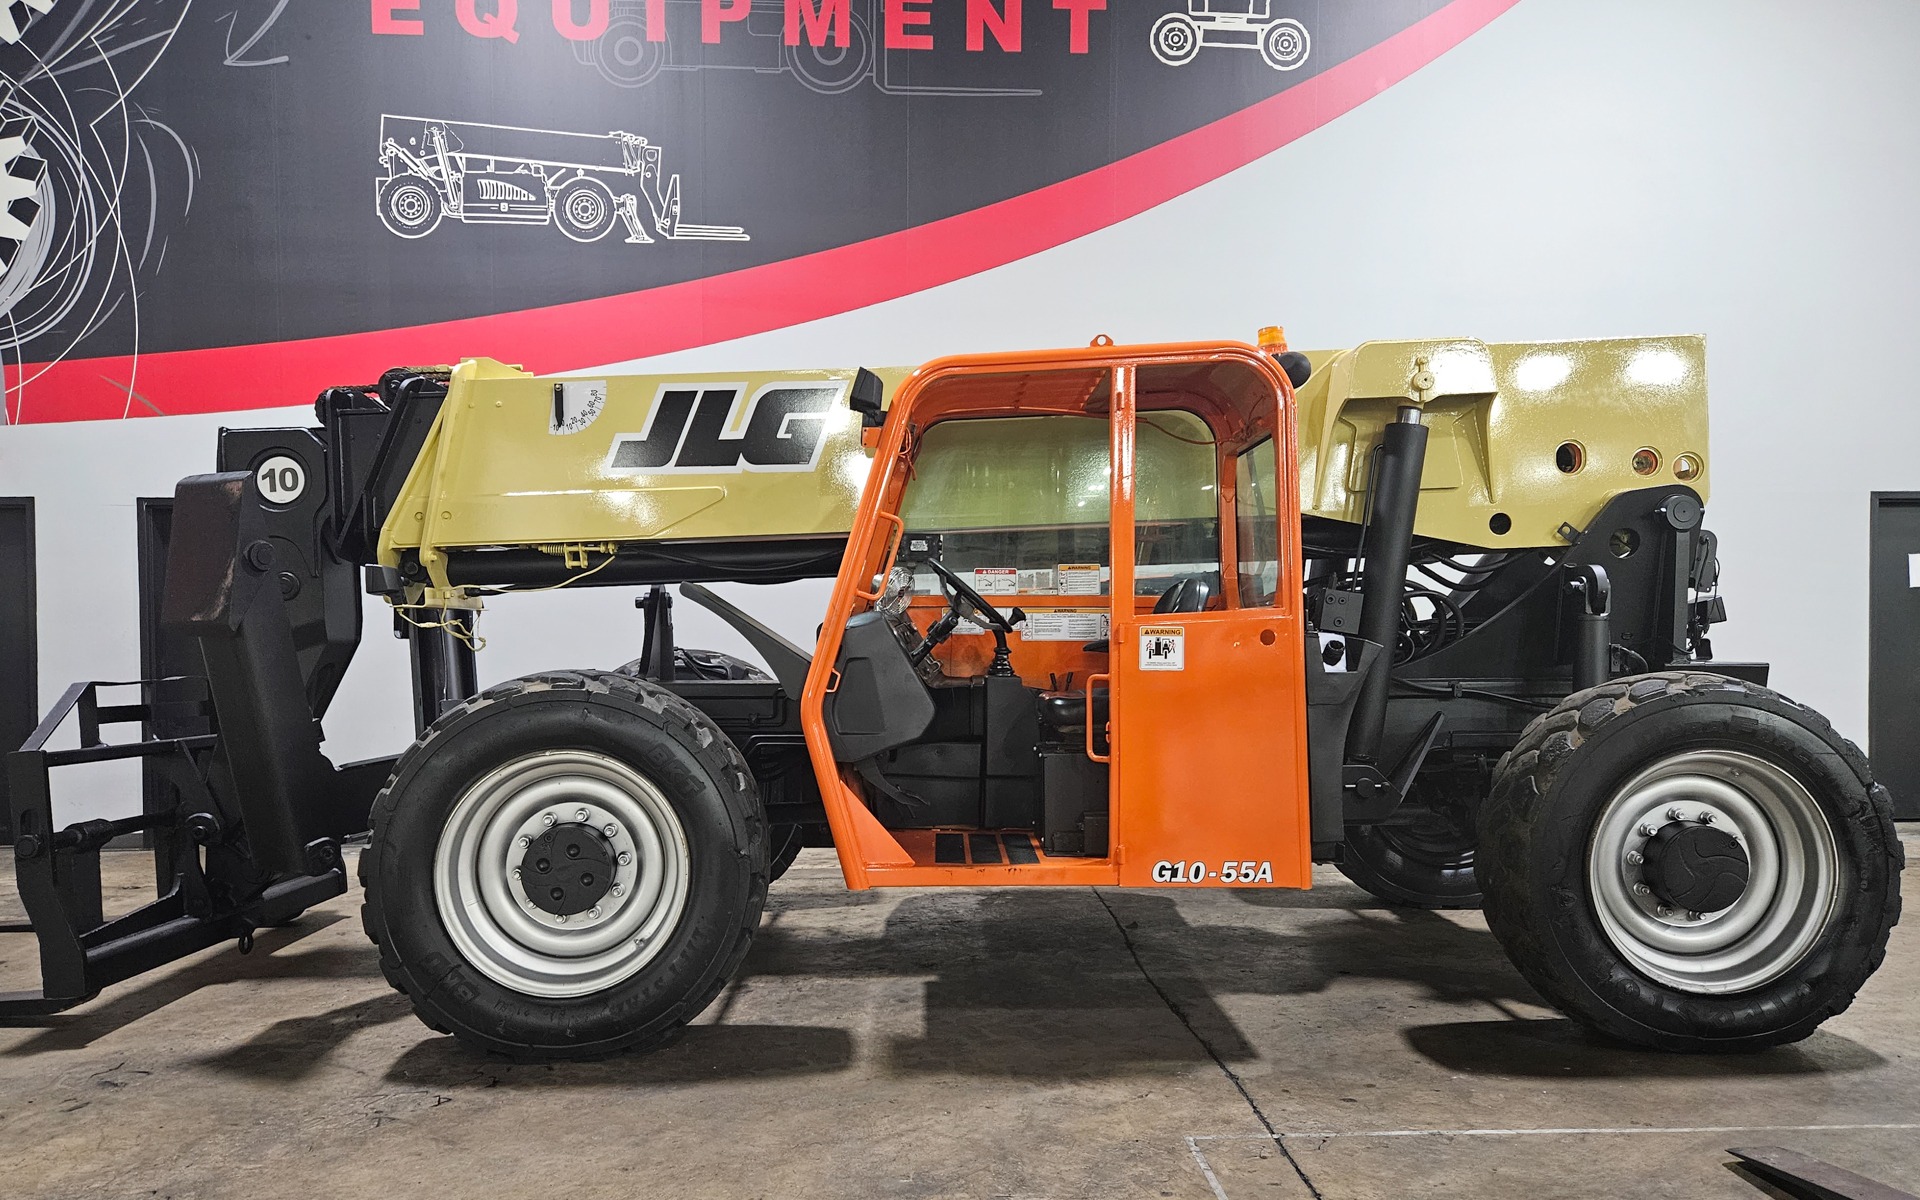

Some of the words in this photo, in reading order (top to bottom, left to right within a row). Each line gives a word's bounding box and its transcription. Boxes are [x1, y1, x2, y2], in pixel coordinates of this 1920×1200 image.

[371, 0, 1107, 54] EQUIPMENT
[605, 383, 846, 470] JLG
[261, 467, 299, 493] 10
[1151, 860, 1273, 884] G10-55A
